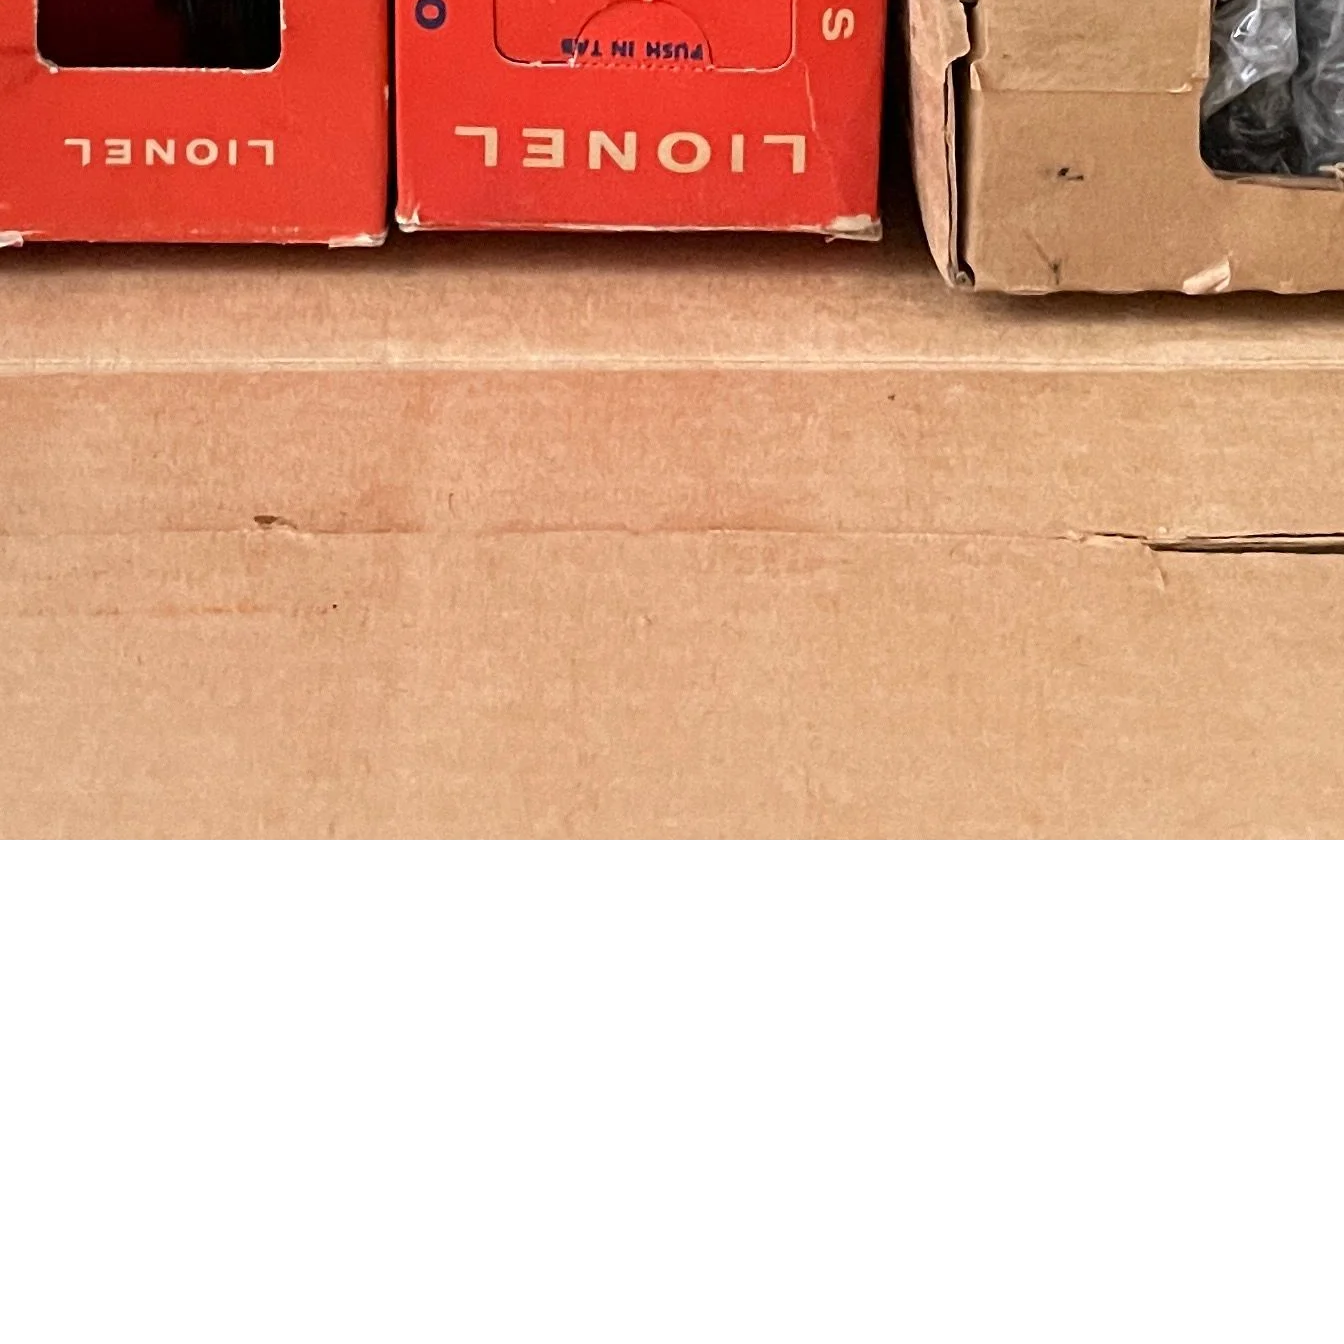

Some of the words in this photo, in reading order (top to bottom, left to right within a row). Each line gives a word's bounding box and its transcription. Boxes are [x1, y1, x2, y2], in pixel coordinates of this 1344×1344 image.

[612, 41, 634, 57] IN
[646, 42, 703, 60] PUSH
[64, 138, 275, 167] LIONEL
[454, 125, 806, 174] LIONEL
